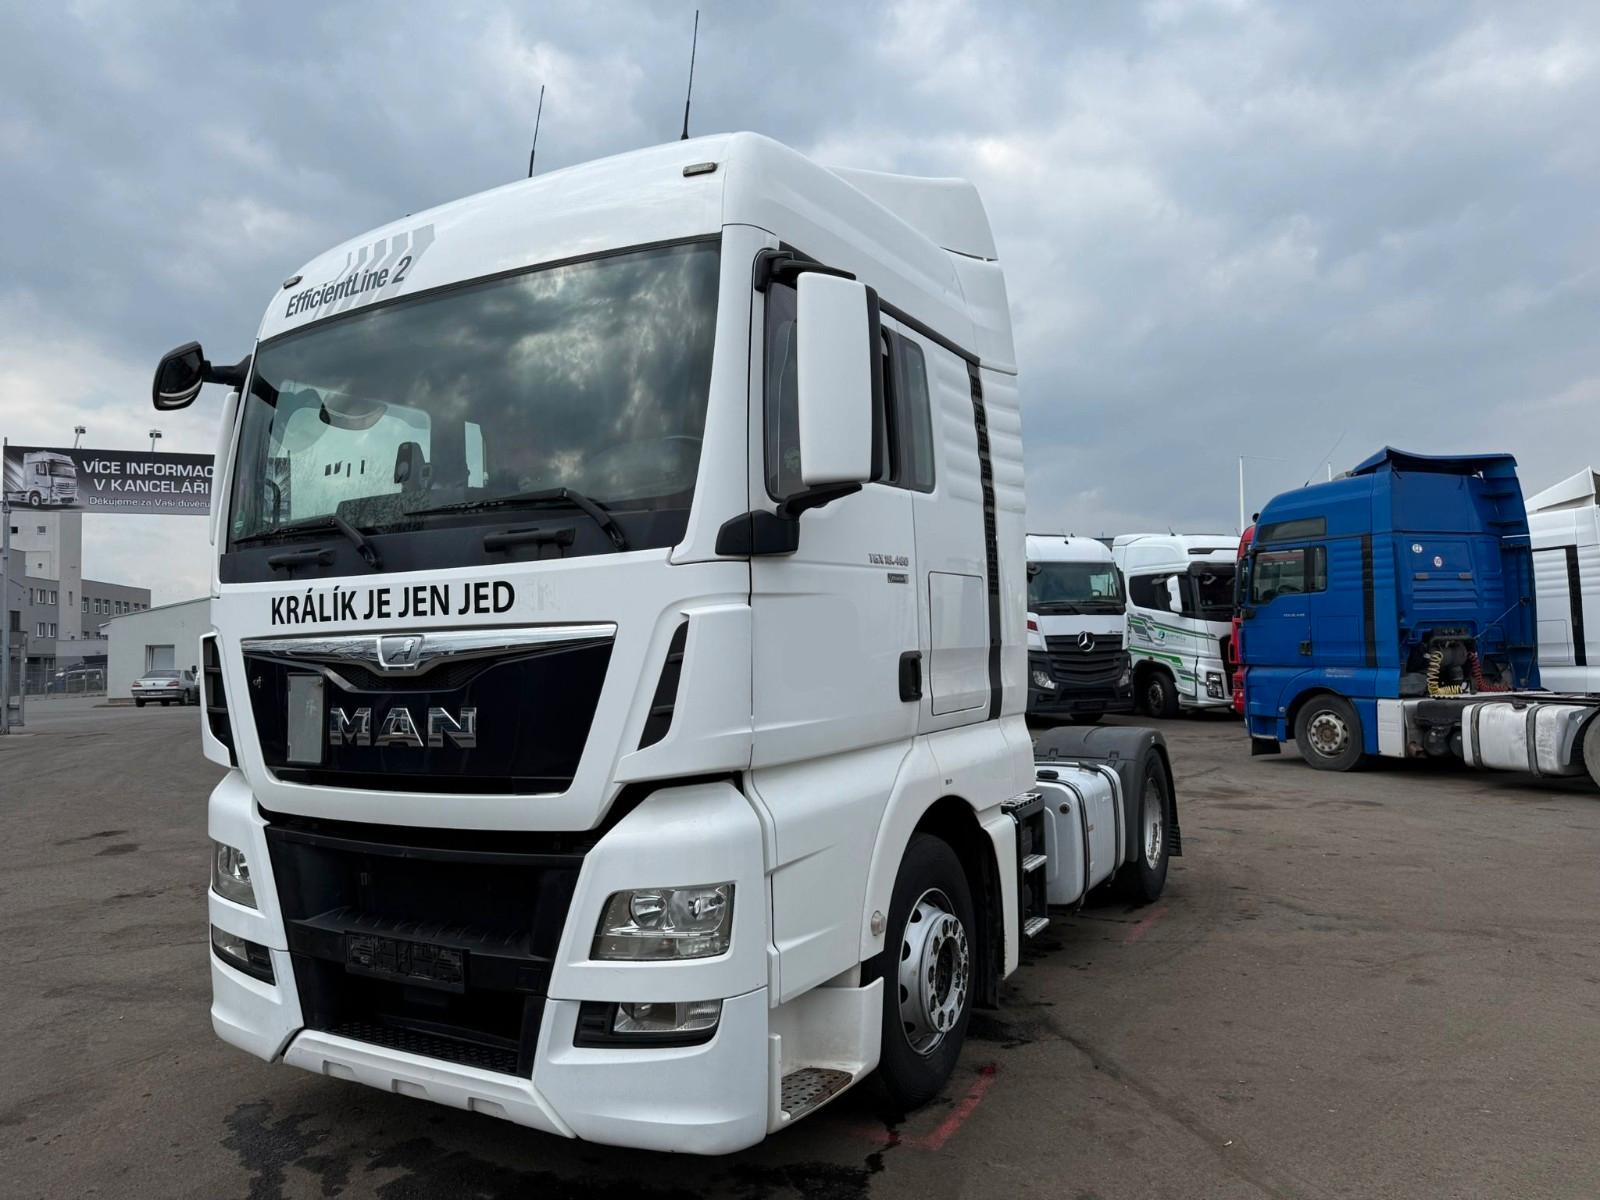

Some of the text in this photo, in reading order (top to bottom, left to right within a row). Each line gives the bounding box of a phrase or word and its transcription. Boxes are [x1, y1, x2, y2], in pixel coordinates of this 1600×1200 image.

[285, 256, 412, 317] EfficientLine 2
[83, 458, 121, 474] VÍCE
[93, 479, 209, 494] V KANCELÁŘI
[272, 585, 358, 625] KRÁLÍK
[363, 588, 391, 620] JE
[398, 584, 450, 618] JEN
[457, 581, 515, 615] JED
[329, 707, 477, 748] MAN
